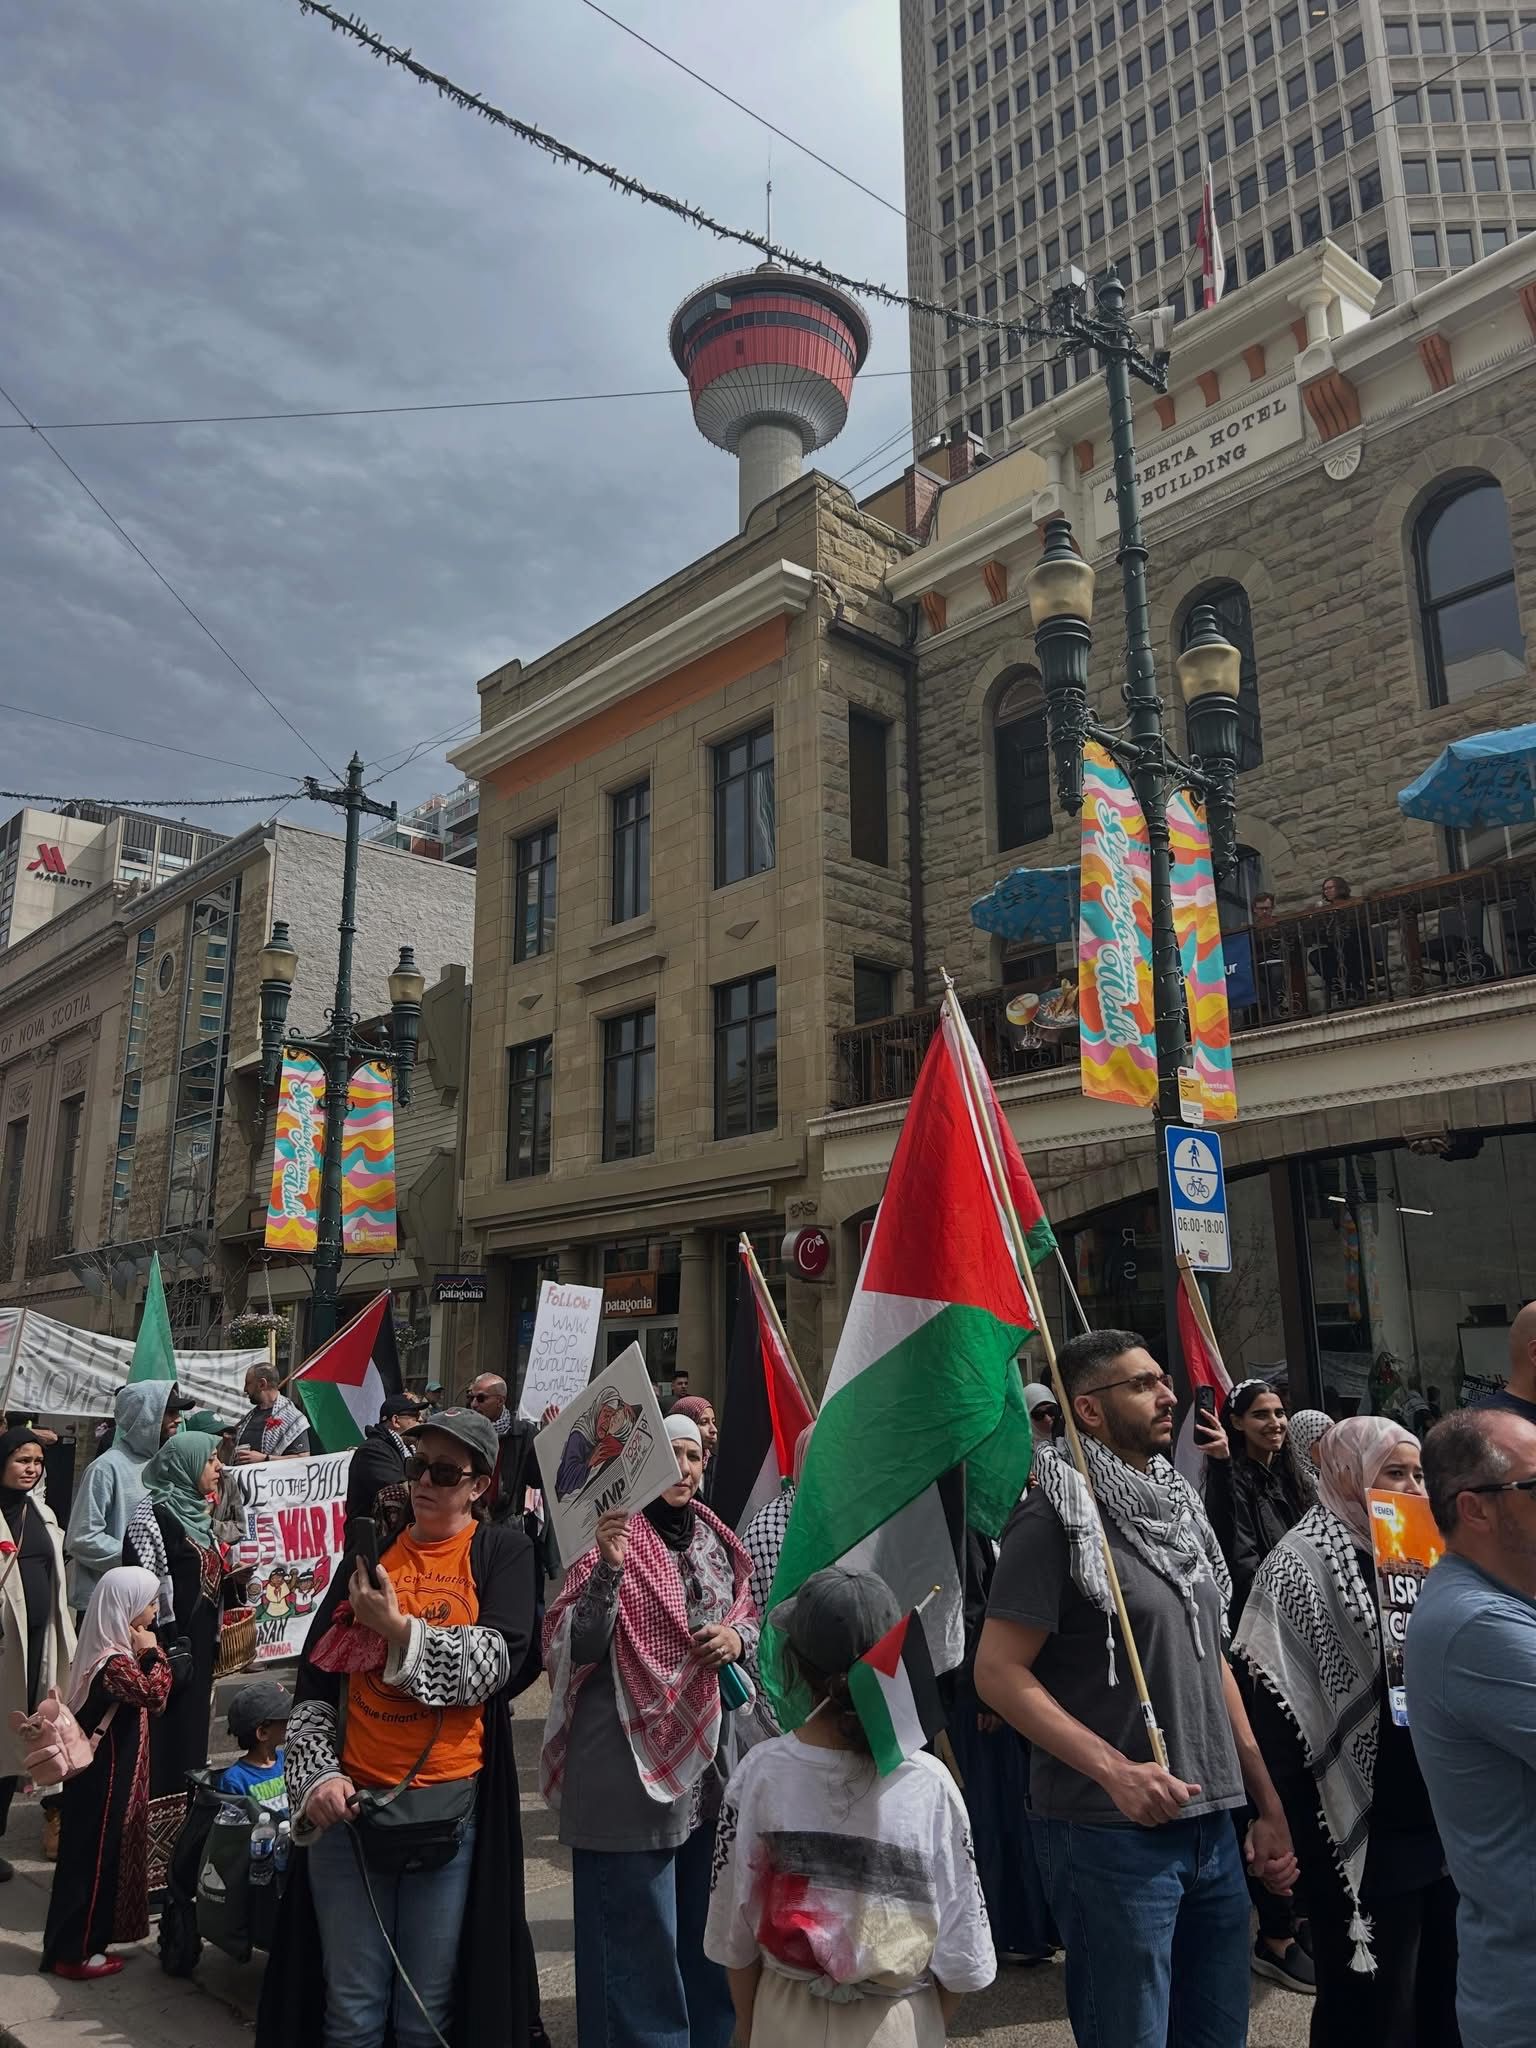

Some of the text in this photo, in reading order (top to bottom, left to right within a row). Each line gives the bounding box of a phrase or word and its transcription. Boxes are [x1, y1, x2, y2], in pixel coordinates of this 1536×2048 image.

[1104, 399, 1287, 503] ABERTA HOTEL
[1141, 444, 1248, 507] BUILDING
[1097, 801, 1139, 920] Stephen
[35, 871, 92, 888] MARRIOTT
[1099, 948, 1139, 1042] Walk
[1, 992, 91, 1054] OF NOVA SCOTIA
[284, 1163, 305, 1216] Walk
[1177, 1217, 1224, 1234] 06:00-18:00
[440, 1289, 483, 1300] patagonia
[605, 1296, 653, 1314] patagonia
[268, 1479, 284, 1497] TO
[285, 1478, 307, 1496] THE
[594, 1477, 626, 1517] MVP
[1374, 1506, 1395, 1517] YEMEN
[278, 1505, 328, 1562] WAR
[256, 1617, 289, 1647] AYAN
[259, 1643, 293, 1658] CANADA
[382, 1711, 419, 1724] Enfant
